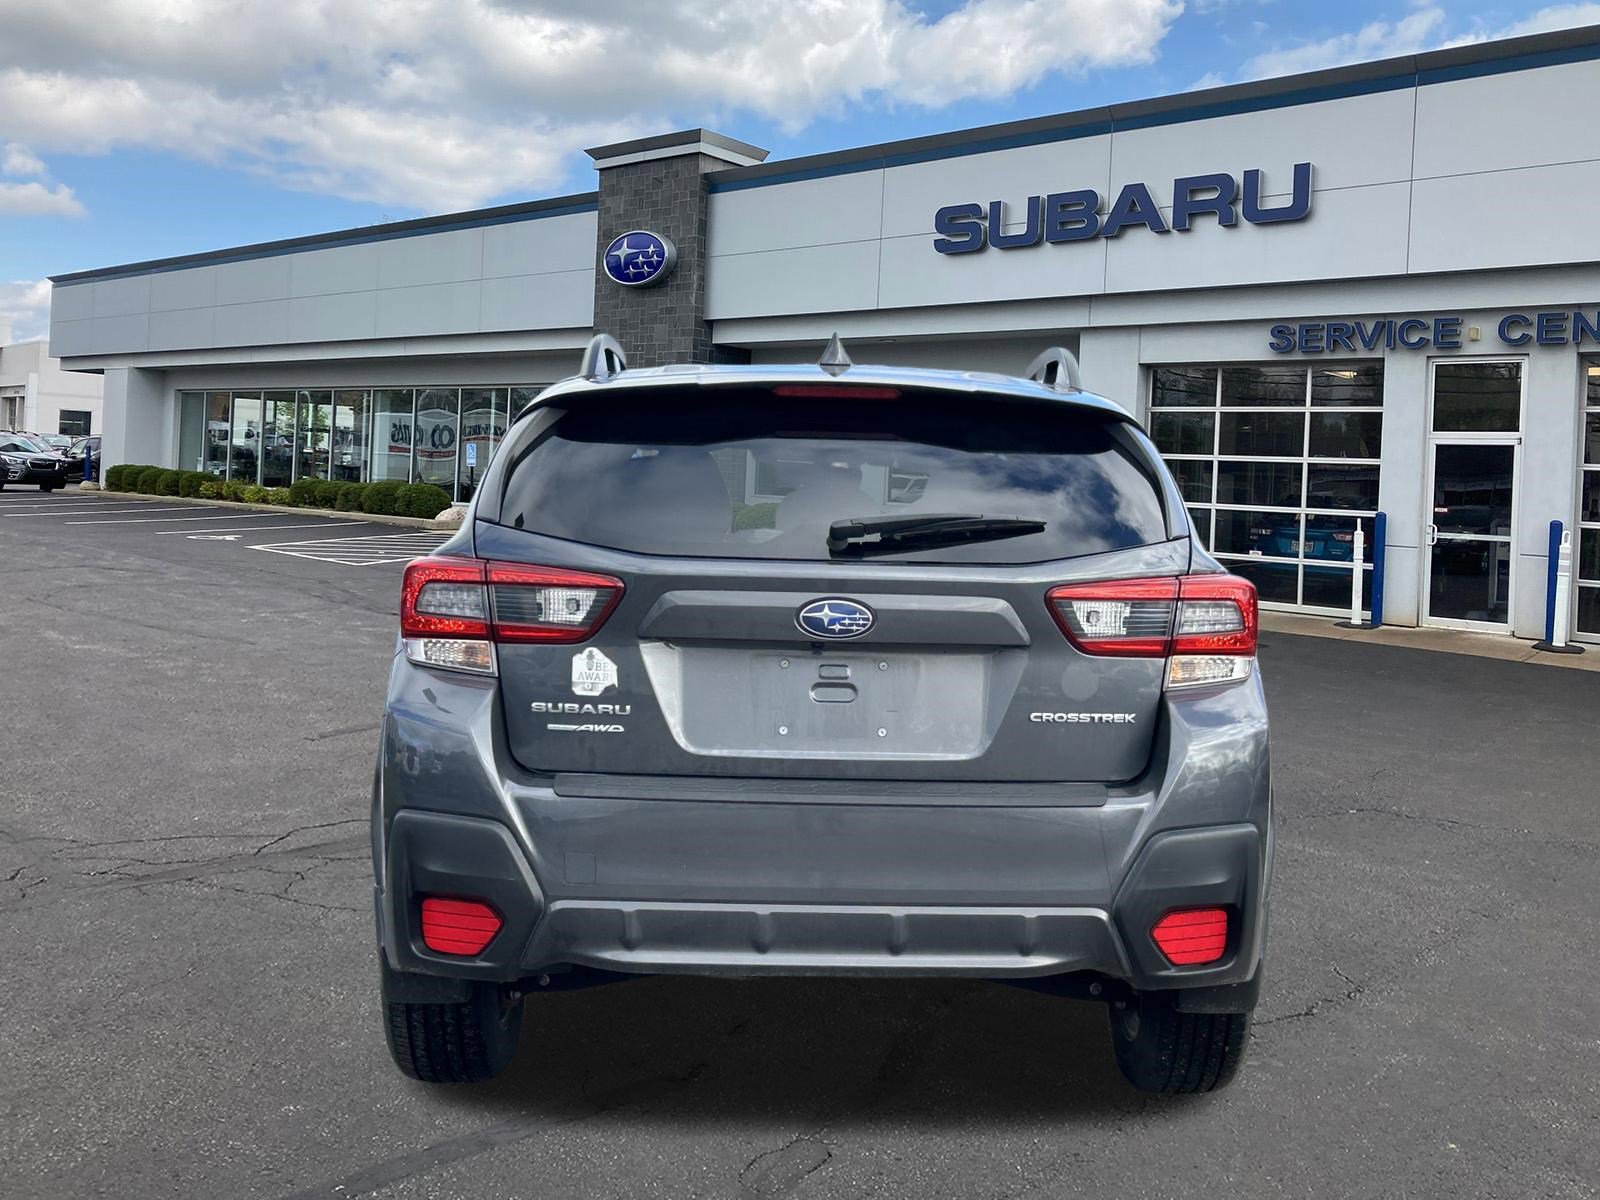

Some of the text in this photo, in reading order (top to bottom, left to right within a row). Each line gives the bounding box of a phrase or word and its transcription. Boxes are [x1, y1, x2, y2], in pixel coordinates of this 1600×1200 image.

[934, 162, 1313, 254] SUBARU
[1269, 311, 1600, 353] SERVICE CEN
[531, 702, 632, 715] SUBARU
[1030, 712, 1136, 723] CROSSTREK
[574, 724, 625, 732] AWD
